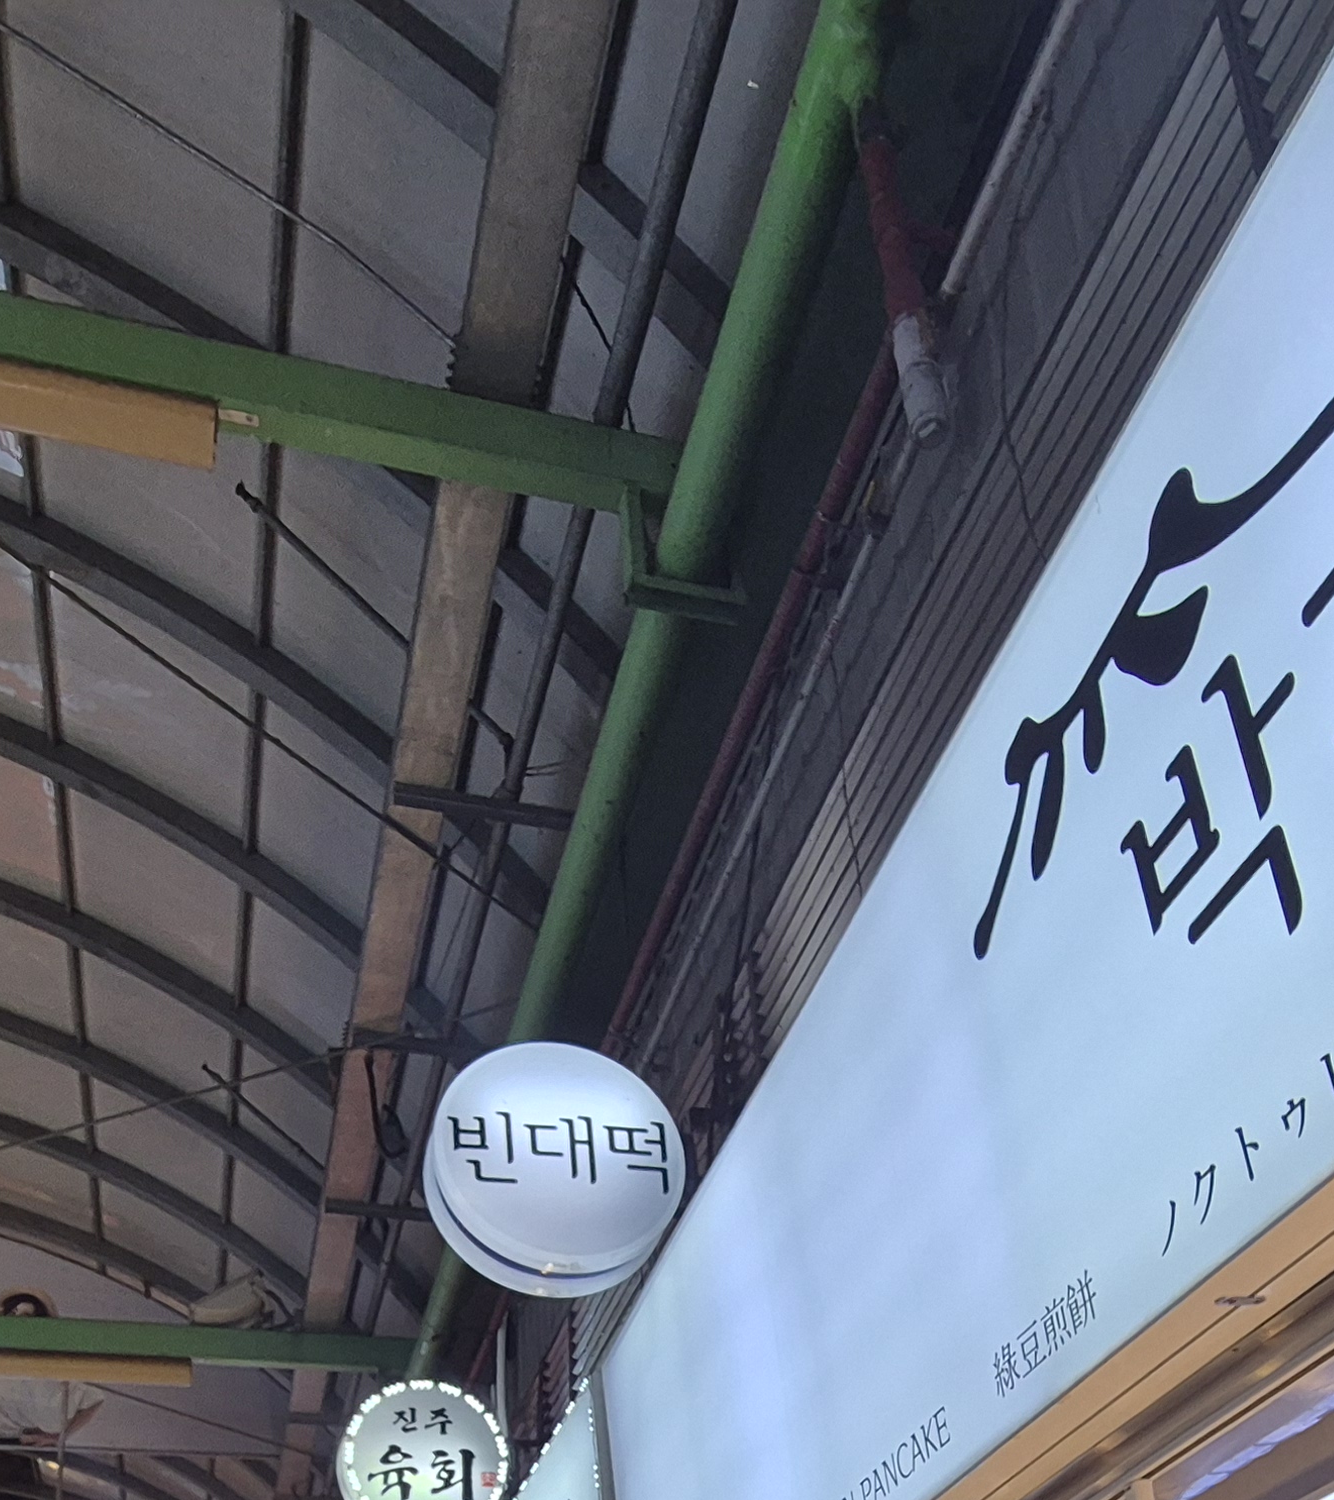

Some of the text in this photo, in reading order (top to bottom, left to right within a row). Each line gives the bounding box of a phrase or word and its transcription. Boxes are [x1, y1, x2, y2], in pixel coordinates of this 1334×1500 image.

[448, 1111, 670, 1194] 빈대떡
[992, 1268, 1097, 1398] 綠豆煎餅
[393, 1407, 454, 1434] 진주
